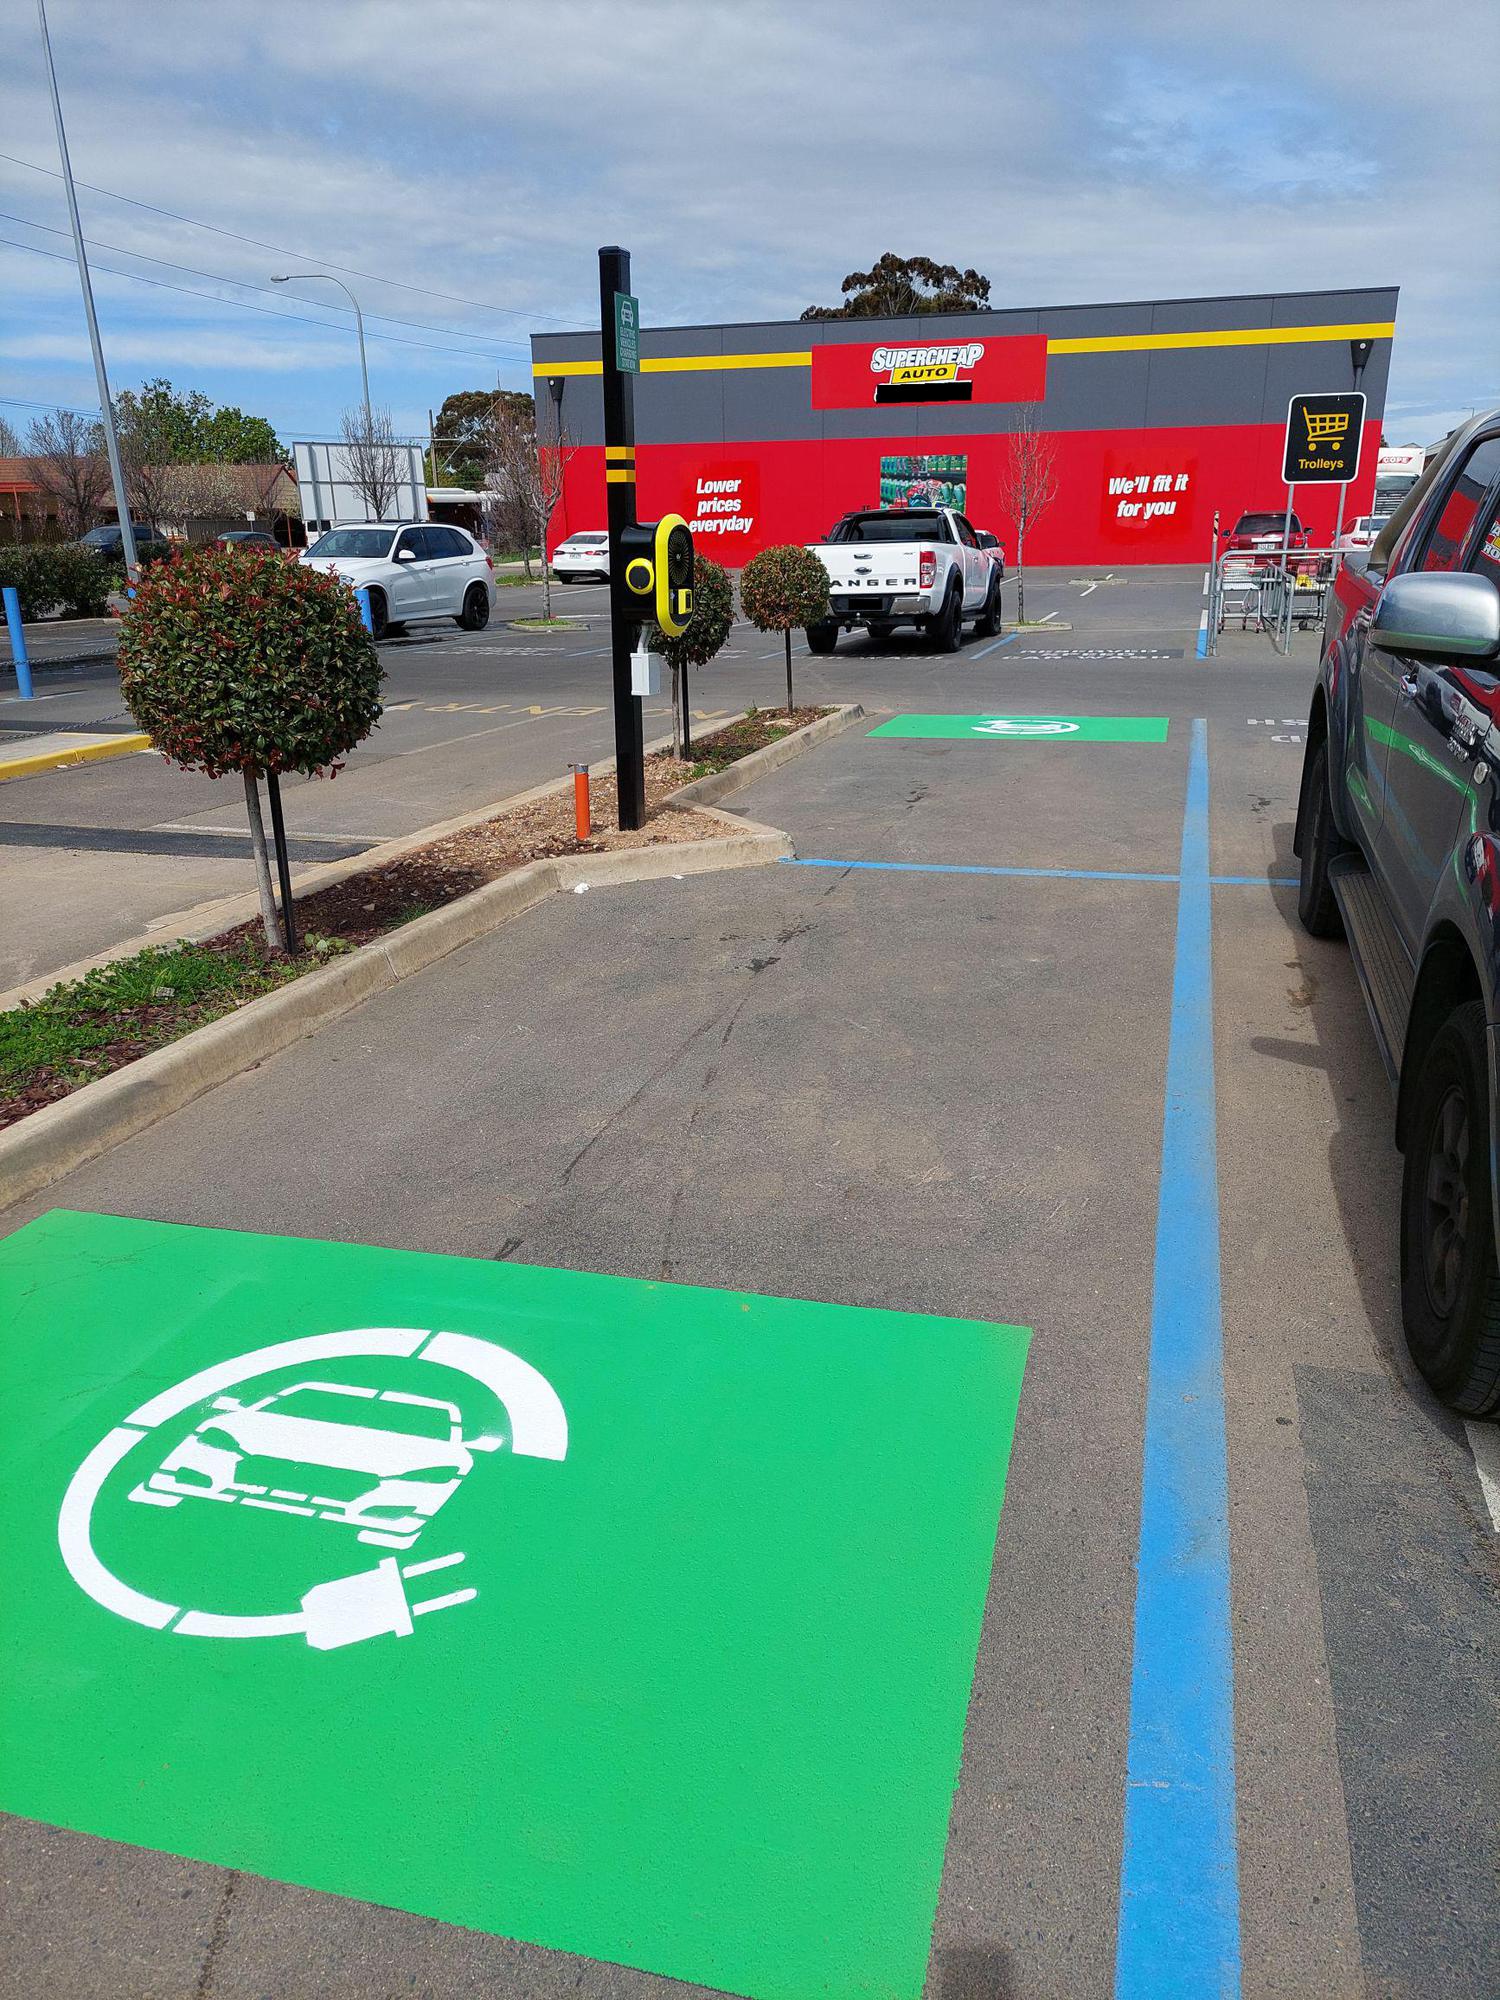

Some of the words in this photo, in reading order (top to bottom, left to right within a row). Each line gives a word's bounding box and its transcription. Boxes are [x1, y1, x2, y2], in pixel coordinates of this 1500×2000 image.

[871, 343, 984, 372] SUPERCHEAP
[900, 367, 948, 379] AUTO
[1298, 458, 1344, 471] Trolleys
[696, 478, 742, 494] Lower
[1109, 476, 1151, 495] We'll
[1152, 474, 1173, 492] fit
[1174, 473, 1189, 491] it
[696, 496, 742, 517] prices
[1116, 500, 1142, 518] for
[1143, 501, 1177, 520] you
[688, 514, 754, 535] everyday
[828, 578, 917, 588] ANGER
